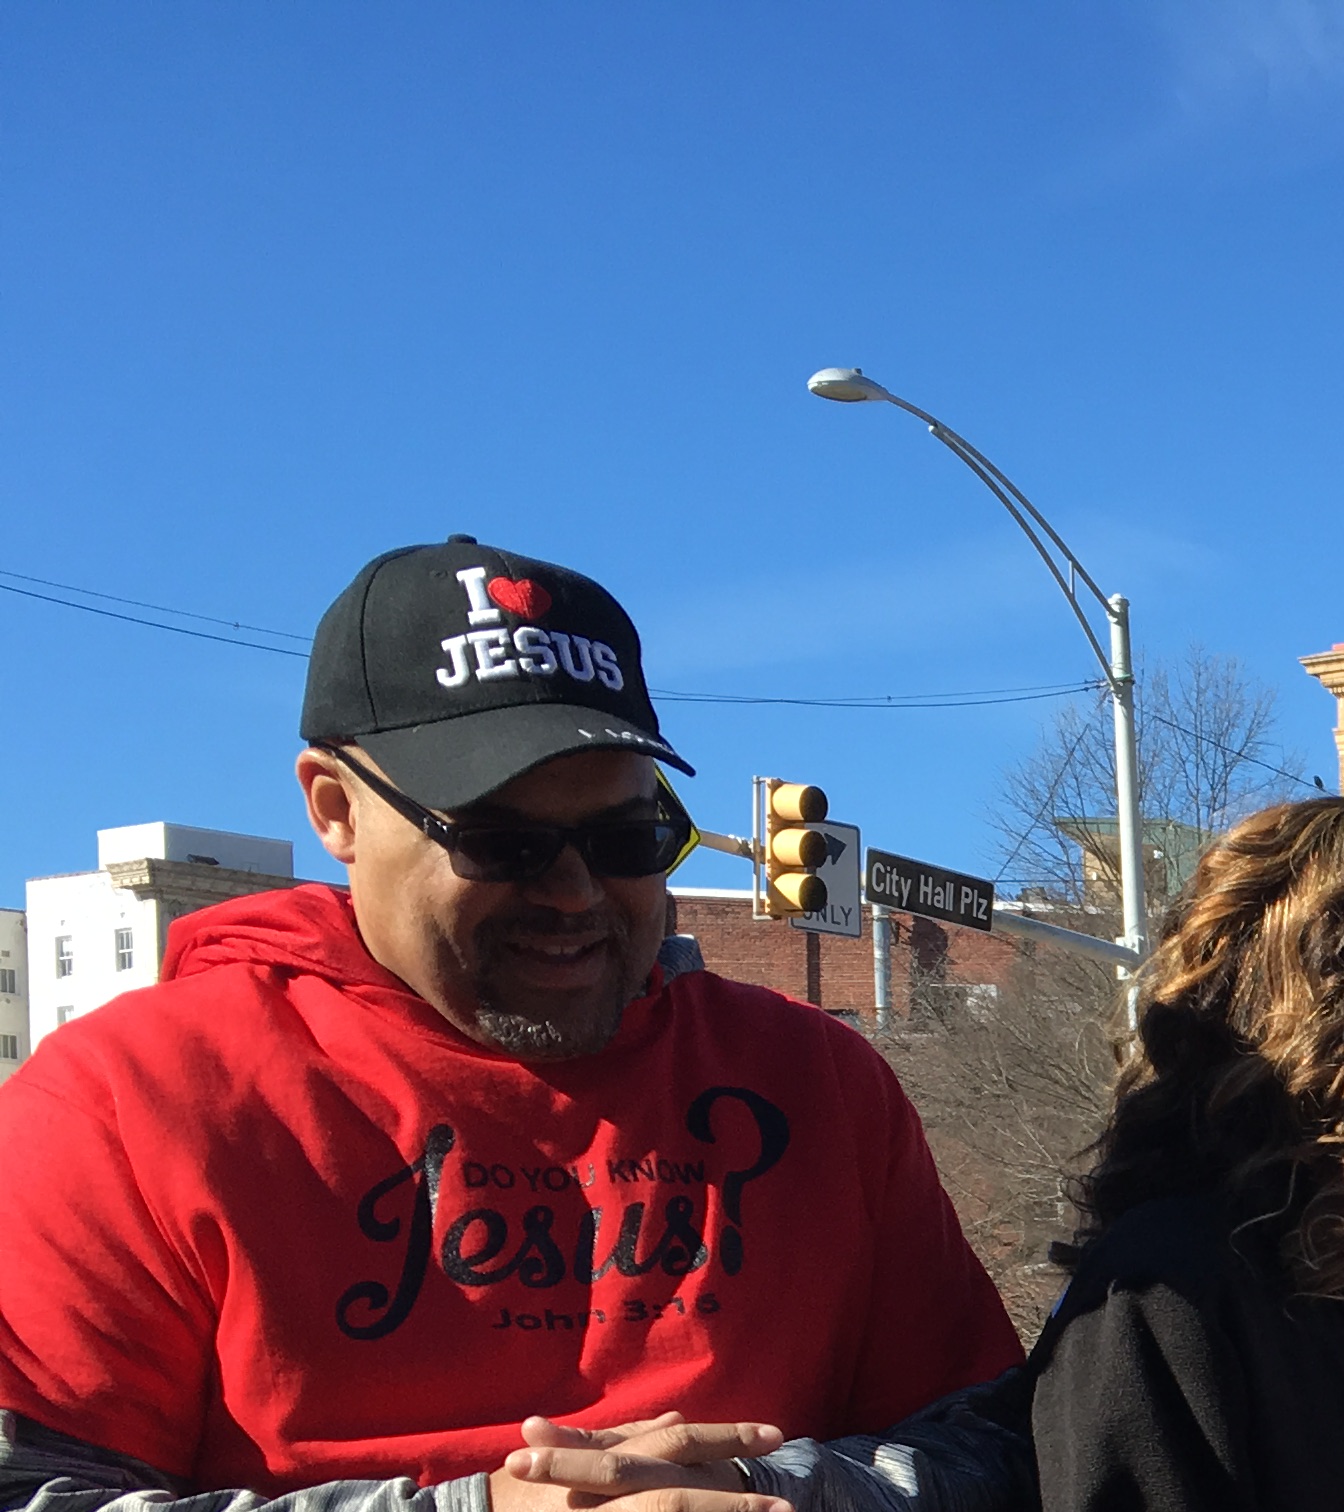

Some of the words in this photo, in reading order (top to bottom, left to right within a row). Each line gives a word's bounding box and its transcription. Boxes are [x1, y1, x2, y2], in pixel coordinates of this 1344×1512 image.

[456, 566, 500, 626] I
[436, 626, 624, 691] JESUS
[872, 861, 911, 907] City
[919, 874, 954, 912] Hall
[960, 887, 988, 921] Plz
[462, 1161, 515, 1189] DO
[520, 1163, 596, 1191] YOU
[607, 1159, 704, 1185] KNOW
[335, 1086, 790, 1341] Jesus?
[492, 1307, 605, 1331] John
